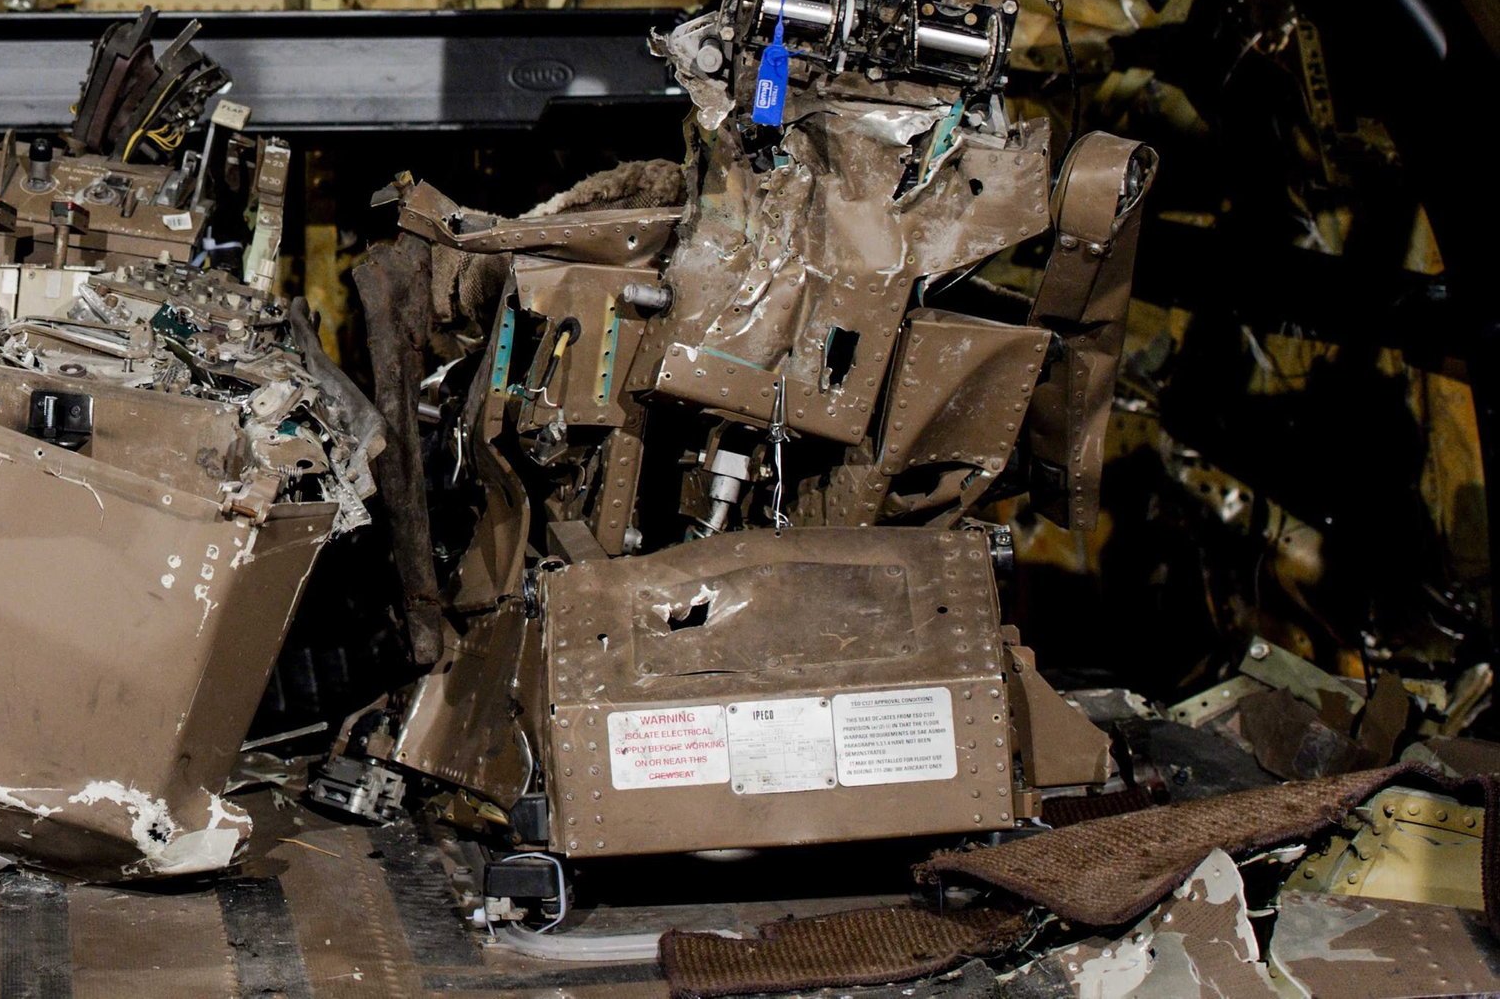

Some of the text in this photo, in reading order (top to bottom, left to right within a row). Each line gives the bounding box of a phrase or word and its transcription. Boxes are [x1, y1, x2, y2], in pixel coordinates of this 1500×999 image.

[221, 105, 243, 113] FLAP
[640, 712, 695, 725] WARNING
[752, 709, 773, 720] IPECO
[624, 727, 713, 740] ISOLATE ELECTRICAL
[869, 730, 910, 738] REQUIREMENTS
[648, 743, 682, 752] BEFORE
[685, 740, 724, 749] WORKING
[663, 757, 686, 765] NEAR
[648, 770, 694, 780] CREWSEAT
